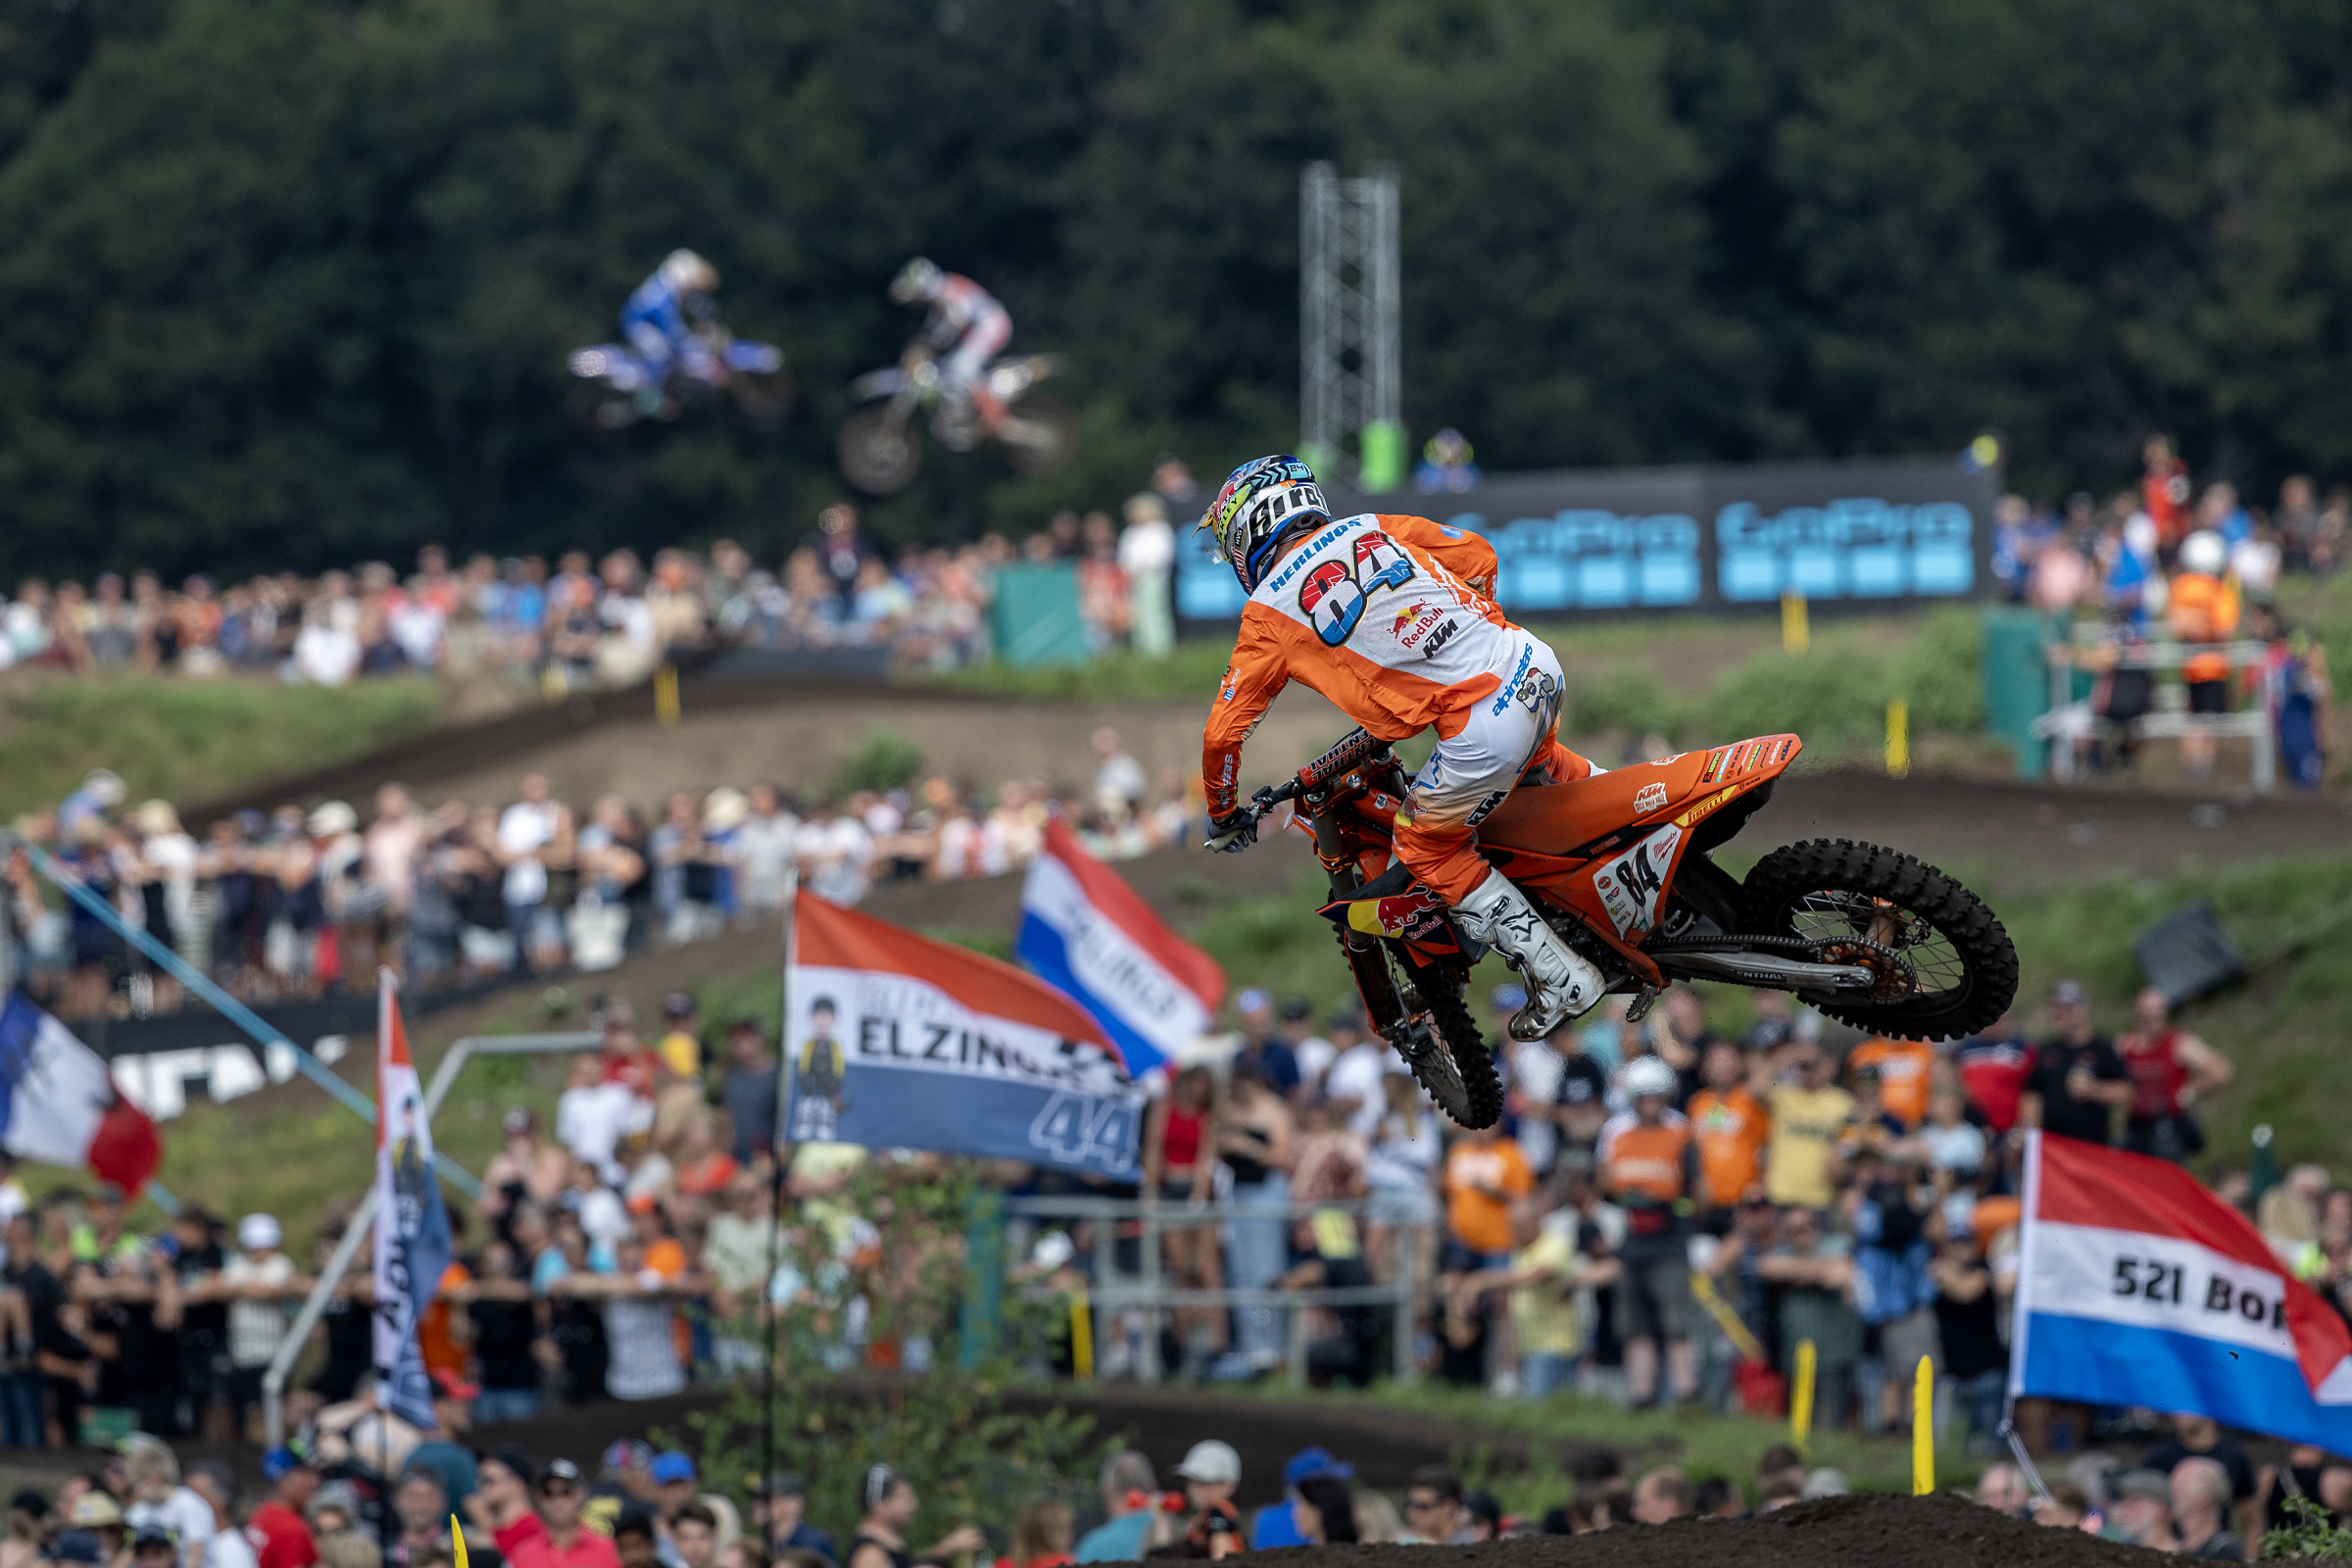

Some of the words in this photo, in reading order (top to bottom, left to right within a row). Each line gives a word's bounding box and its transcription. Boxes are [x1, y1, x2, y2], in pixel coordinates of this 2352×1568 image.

[1717, 498, 1973, 546] GoPro
[1297, 530, 1417, 648] 84
[1400, 620, 1428, 649] Red
[1423, 607, 1445, 628] Bull
[1422, 618, 1459, 659] KTM
[1492, 642, 1534, 717] alpinestars
[1307, 729, 1371, 771] ENTHAL
[1468, 790, 1509, 826] KTM
[1638, 784, 1662, 801] KTM
[1687, 790, 1725, 824] PIRELLI
[1615, 843, 1662, 907] 84
[1406, 925, 1427, 940] Red
[1423, 914, 1444, 930] Bull
[1029, 1090, 1140, 1174] 44
[2112, 1254, 2185, 1305] 521
